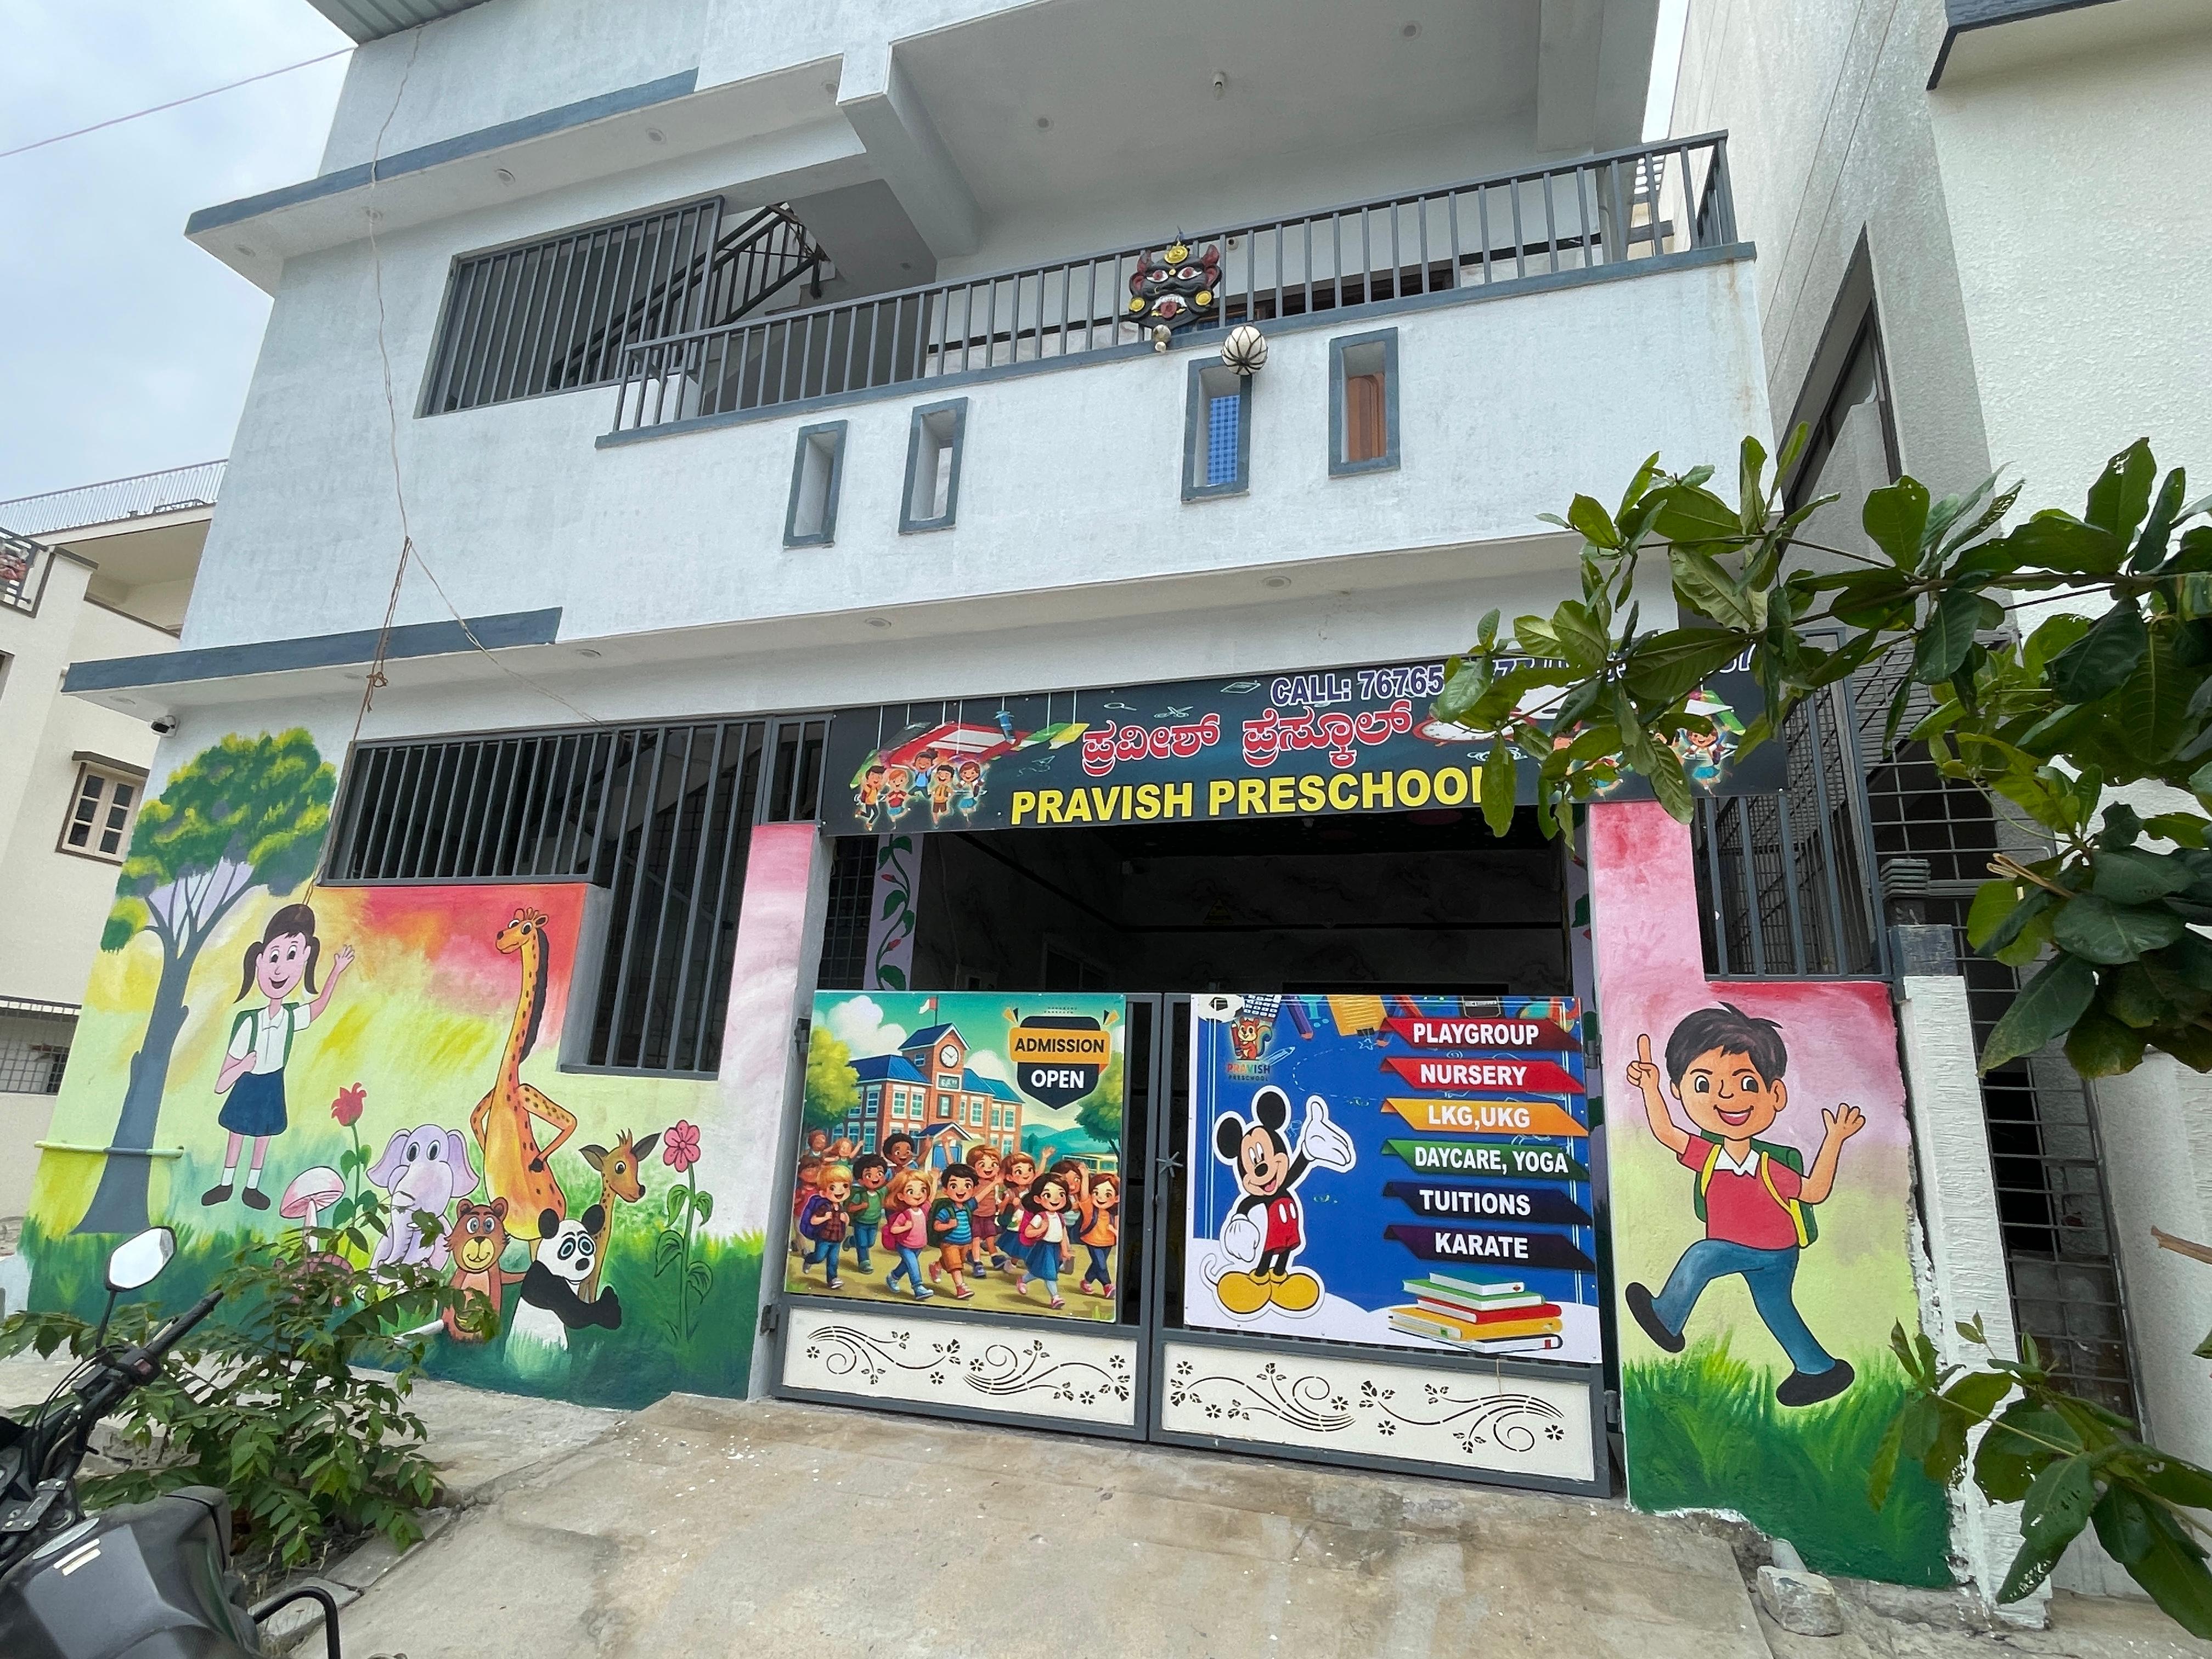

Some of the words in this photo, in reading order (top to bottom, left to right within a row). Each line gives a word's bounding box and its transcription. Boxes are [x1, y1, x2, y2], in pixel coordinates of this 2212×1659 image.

[1271, 673, 1352, 707] CALL:
[1082, 713, 1220, 777] ಪ್ರವೀಶ್
[1243, 699, 1413, 769] ಪ್ರೆಸ್ಕೂಲ್
[1011, 782, 1193, 825] PRAVISH
[1015, 1038, 1105, 1053] ADMISSION
[1413, 1023, 1539, 1045] PLAYGROUP
[1031, 1069, 1085, 1088] OPEN
[1227, 1063, 1271, 1074] PRAVISH
[1420, 1064, 1527, 1086] NURSERY
[1414, 1147, 1508, 1175] DAYCARE,
[1512, 1151, 1569, 1173] YOGA
[1419, 1189, 1531, 1216] TUITIONS
[1435, 1232, 1530, 1259] KARATE
